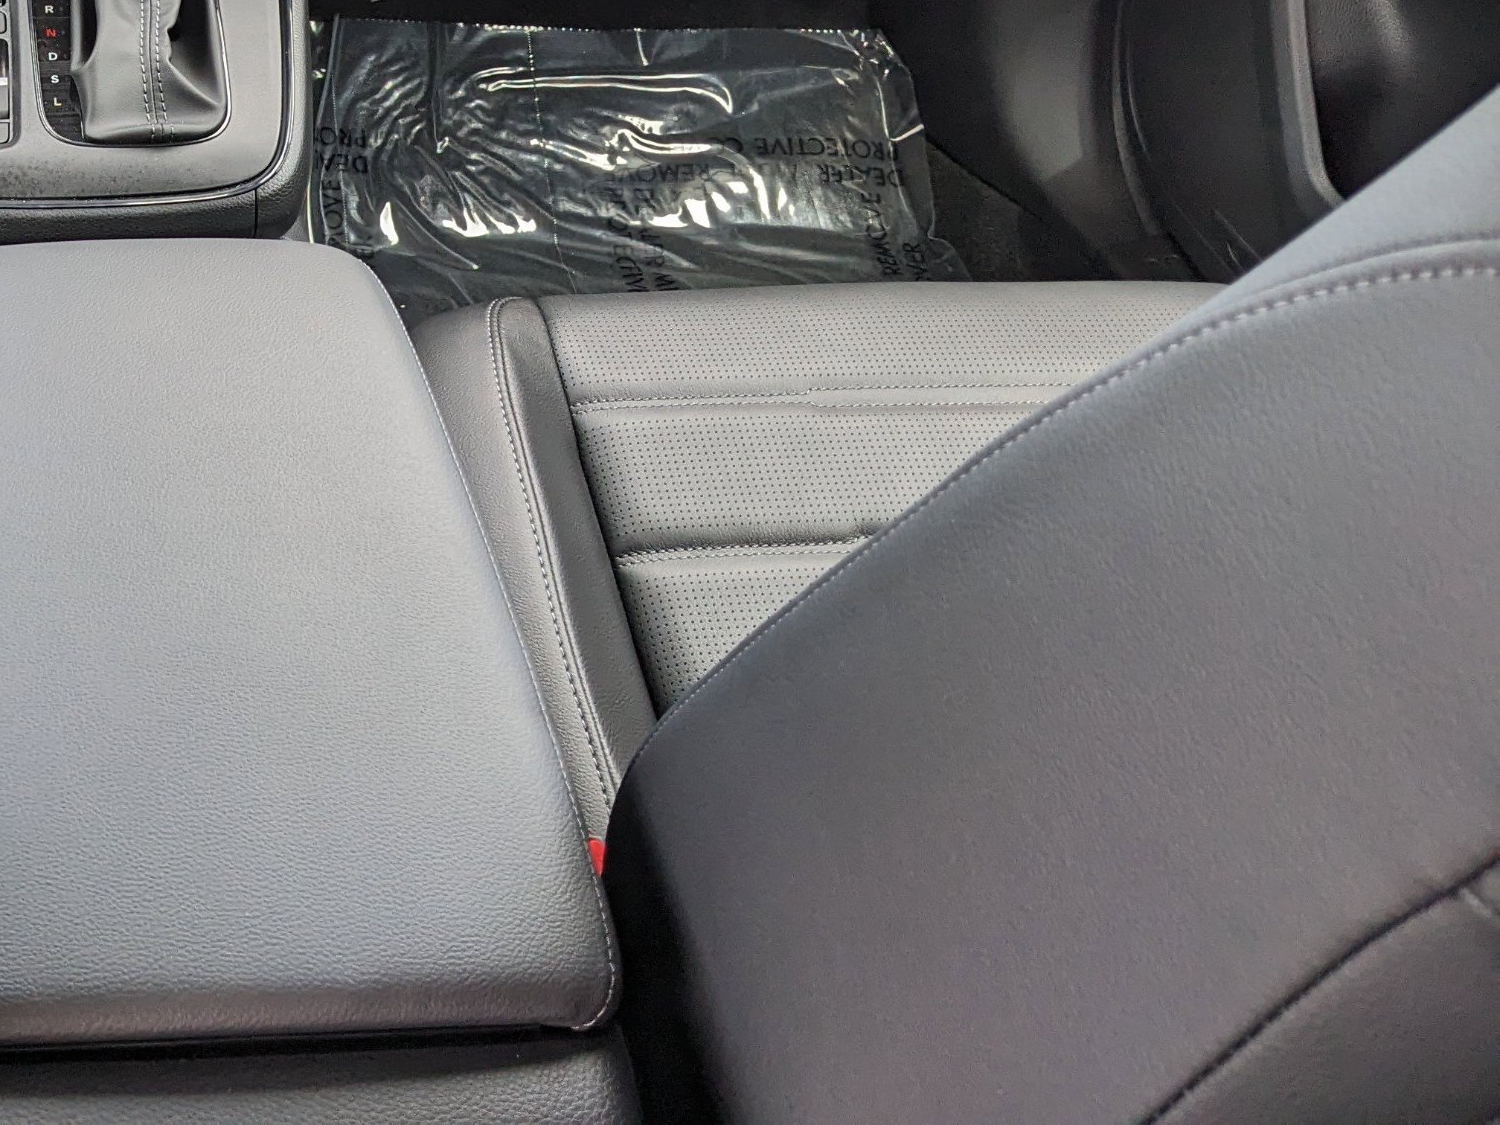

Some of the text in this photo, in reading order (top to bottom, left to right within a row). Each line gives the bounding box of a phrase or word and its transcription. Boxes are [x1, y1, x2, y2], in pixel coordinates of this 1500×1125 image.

[45, 5, 54, 14] R
[46, 29, 56, 37] N
[48, 52, 58, 61] D
[50, 75, 60, 84] S
[54, 97, 62, 106] L
